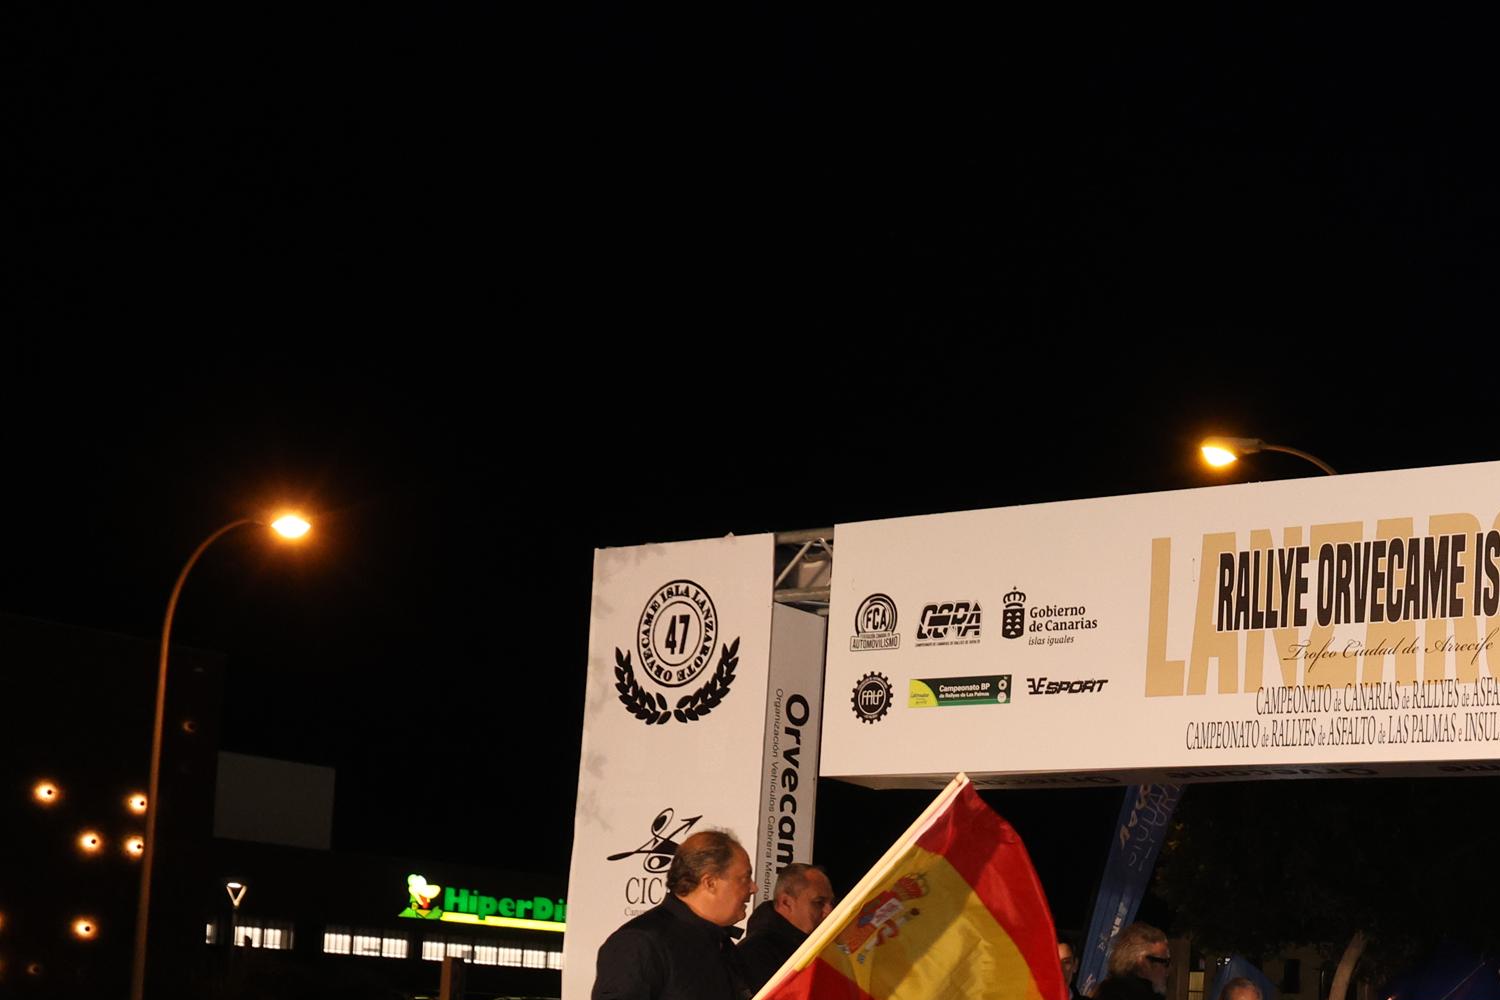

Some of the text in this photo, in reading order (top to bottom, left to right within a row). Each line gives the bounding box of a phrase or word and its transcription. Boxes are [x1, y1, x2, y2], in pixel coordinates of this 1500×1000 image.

[1217, 546, 1310, 633] RALLYE
[1316, 533, 1465, 627] ORVECAME
[866, 607, 887, 630] FCA
[1029, 605, 1086, 619] Gobierno
[1029, 617, 1098, 632] de Canarias
[665, 614, 690, 655] 47
[852, 636, 898, 649] AUTOMOVILISMO
[1028, 634, 1075, 646] islas iguales
[1283, 627, 1499, 672] Trofeo Ciudad de Arrecife
[939, 684, 979, 693] Campeonato
[1256, 684, 1331, 715] CAMPEONATO
[1333, 691, 1341, 711] de
[1344, 681, 1400, 712] CANARIAS
[1402, 688, 1409, 709] de
[1412, 679, 1459, 709] RALLYES
[1462, 685, 1469, 706] de
[769, 688, 783, 758] Organización
[1186, 720, 1260, 750] CAMPEONATO
[1261, 727, 1269, 747] de
[1271, 718, 1316, 747] RALLYES
[1318, 725, 1325, 745] de
[1327, 715, 1376, 745] ASFALTO
[1378, 723, 1385, 744] de
[1388, 715, 1409, 744] LAS
[1411, 713, 1456, 743] PALMAS
[1458, 726, 1462, 742] e
[776, 693, 809, 875] Orvecam
[765, 815, 776, 858] Cabrera
[625, 876, 663, 905] CIC
[763, 861, 774, 900] Medina
